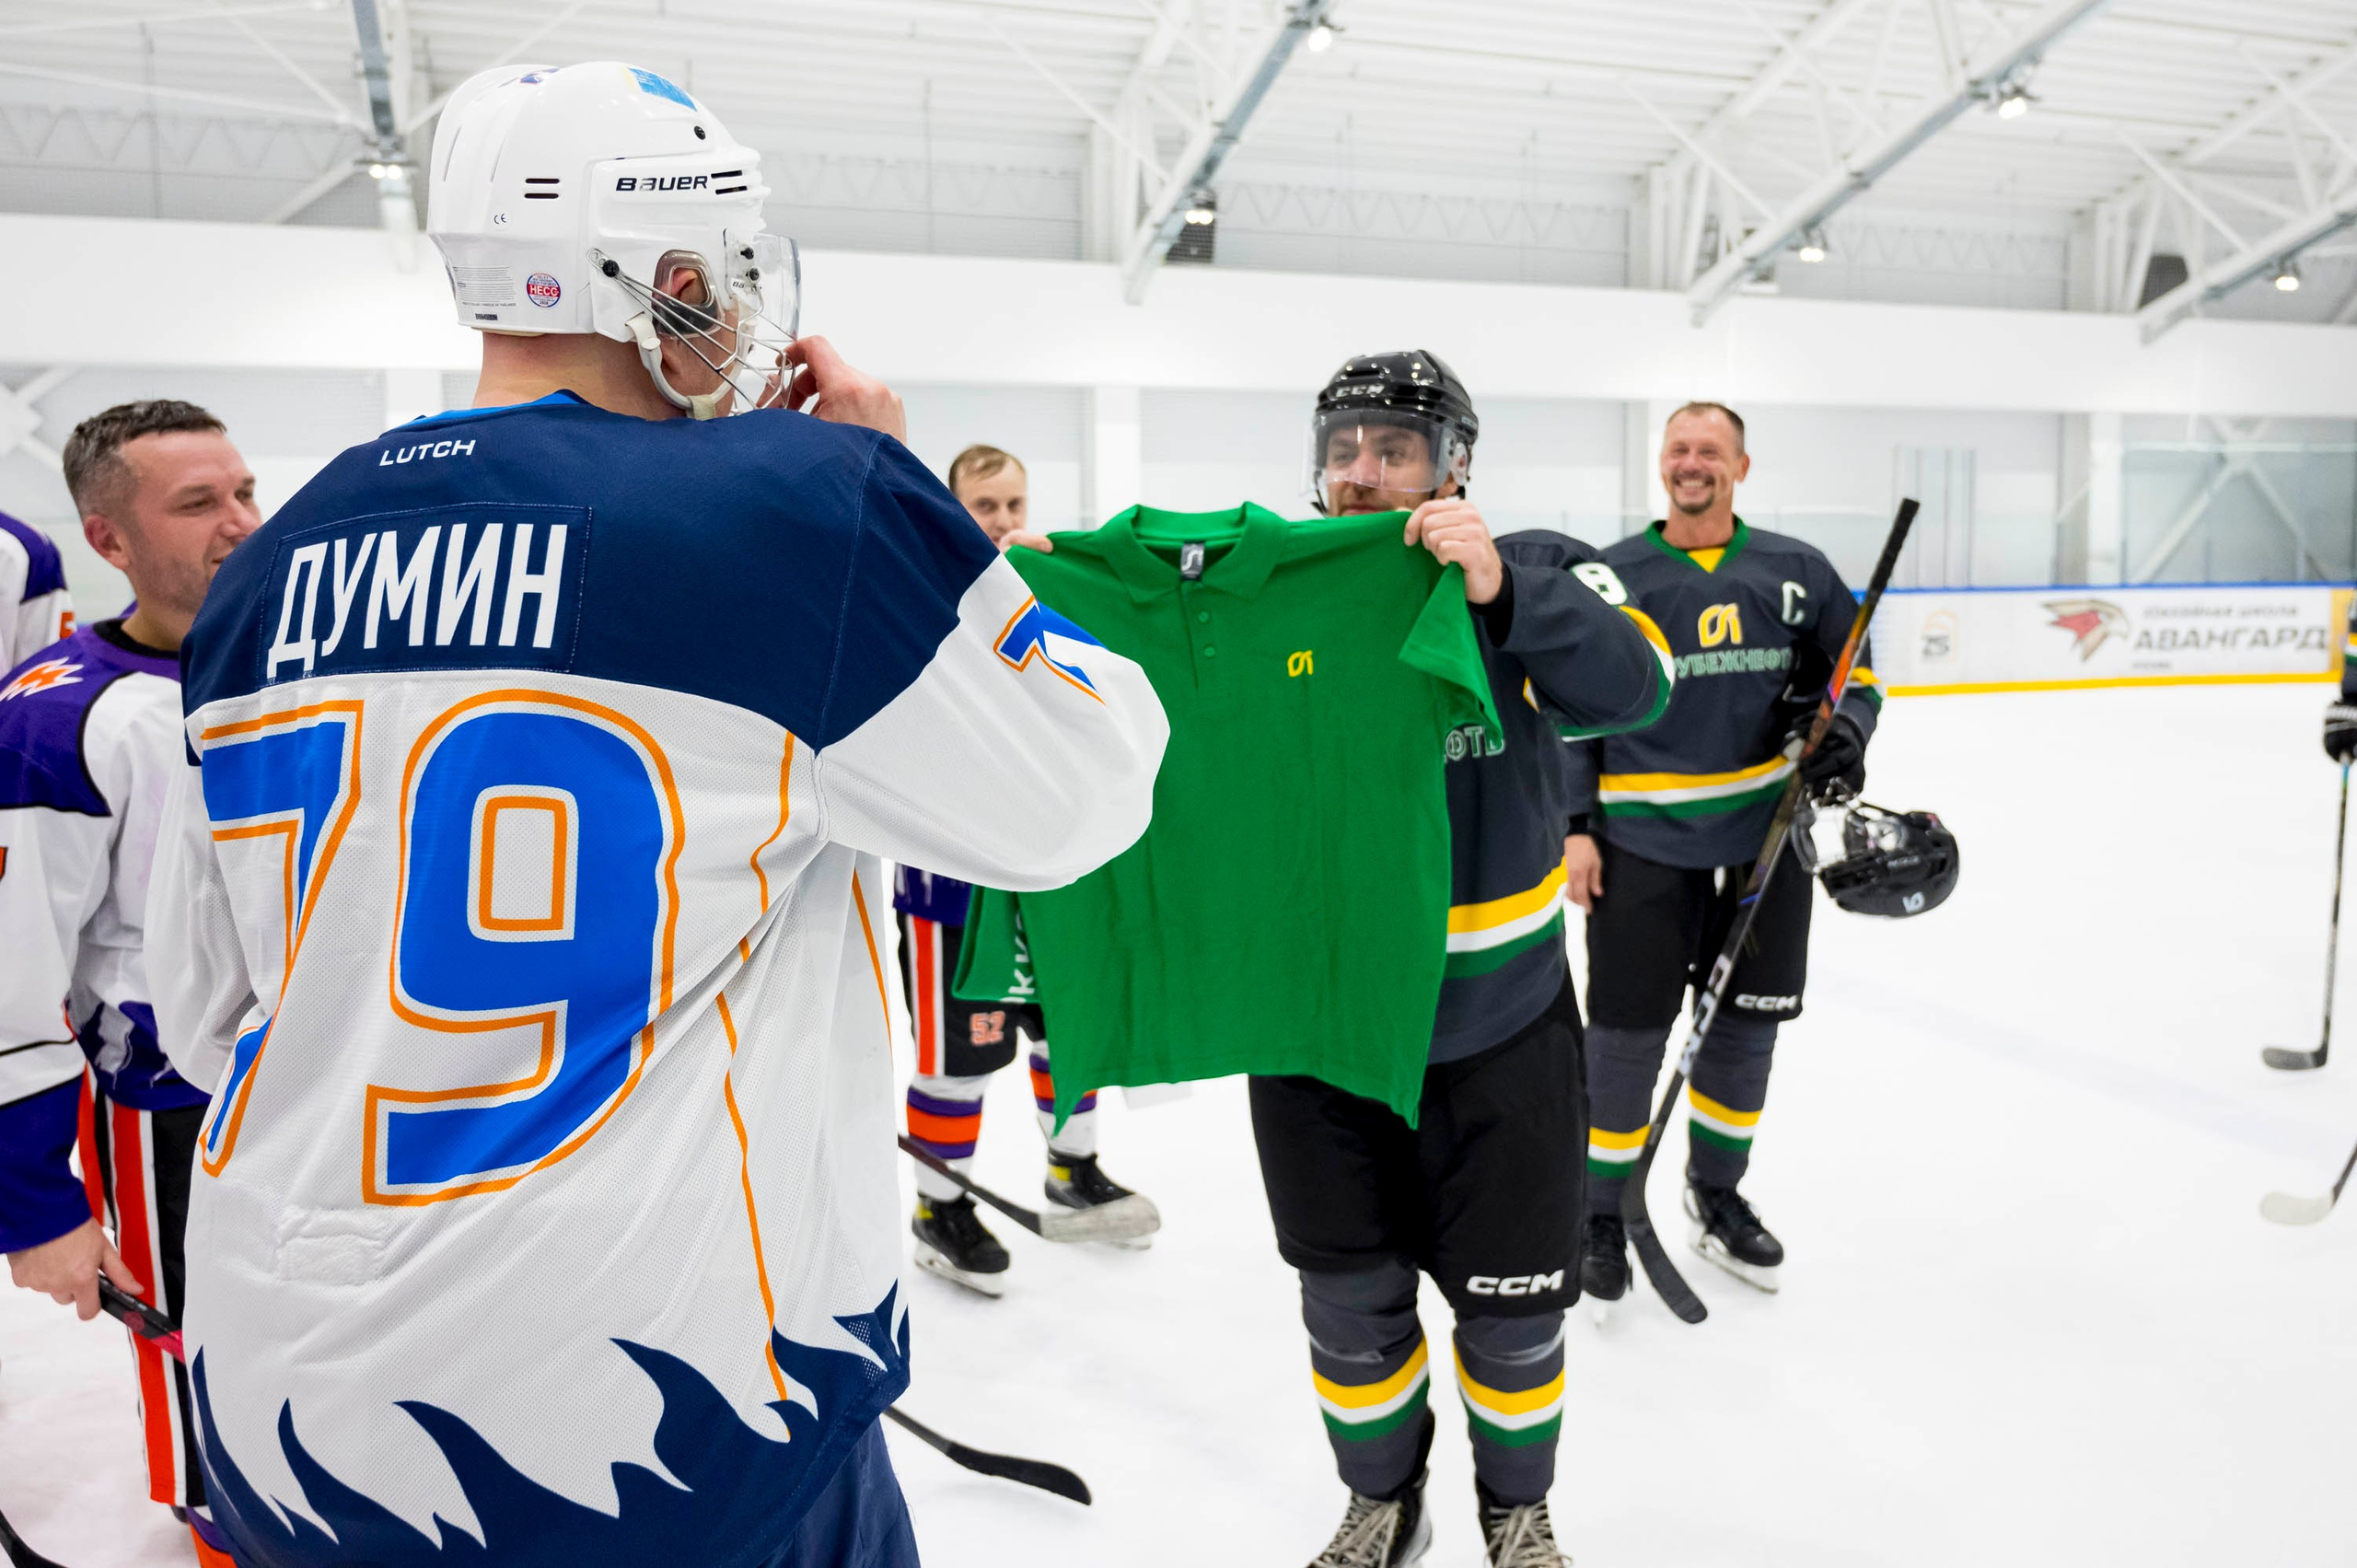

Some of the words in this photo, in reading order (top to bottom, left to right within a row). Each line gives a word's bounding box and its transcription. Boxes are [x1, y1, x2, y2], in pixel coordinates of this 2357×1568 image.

[379, 439, 476, 466] LUTCH
[266, 523, 568, 679] ДУМИН
[1782, 581, 1806, 624] C
[2133, 626, 2328, 650] АВАНГАРД
[199, 689, 685, 1207] 79
[1735, 993, 1798, 1011] CCM
[1467, 1270, 1564, 1296] CCM
